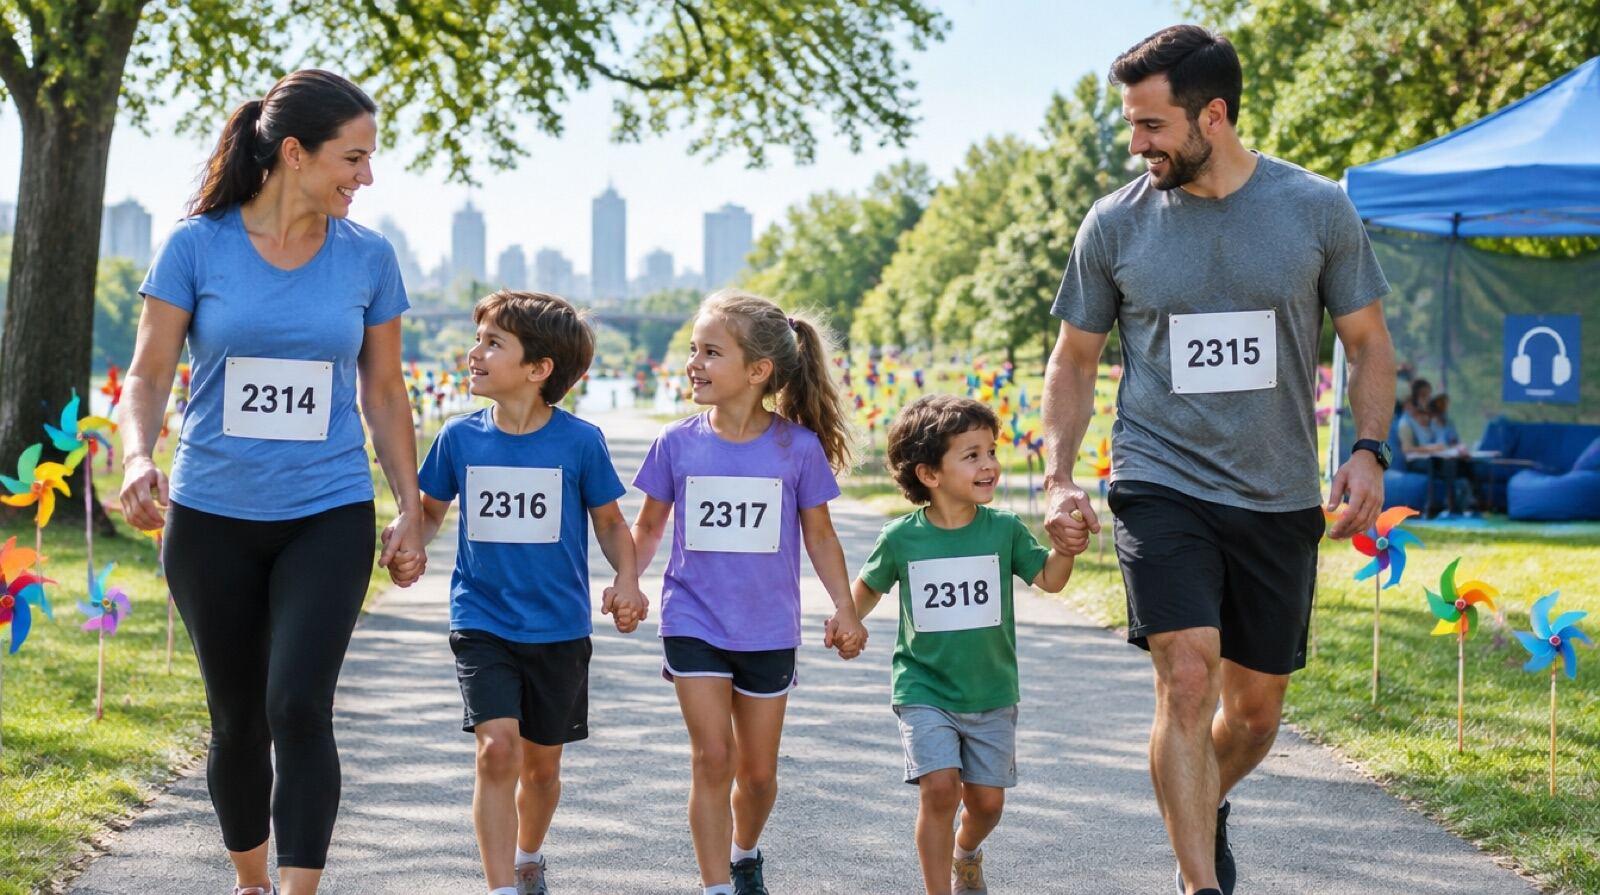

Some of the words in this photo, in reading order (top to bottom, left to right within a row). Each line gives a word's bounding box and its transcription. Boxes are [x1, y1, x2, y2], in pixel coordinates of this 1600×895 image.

[1187, 337, 1261, 368] 2315
[241, 384, 316, 415] 2314
[479, 491, 547, 519] 2316
[699, 500, 768, 528] 2317
[923, 579, 989, 609] 2318
